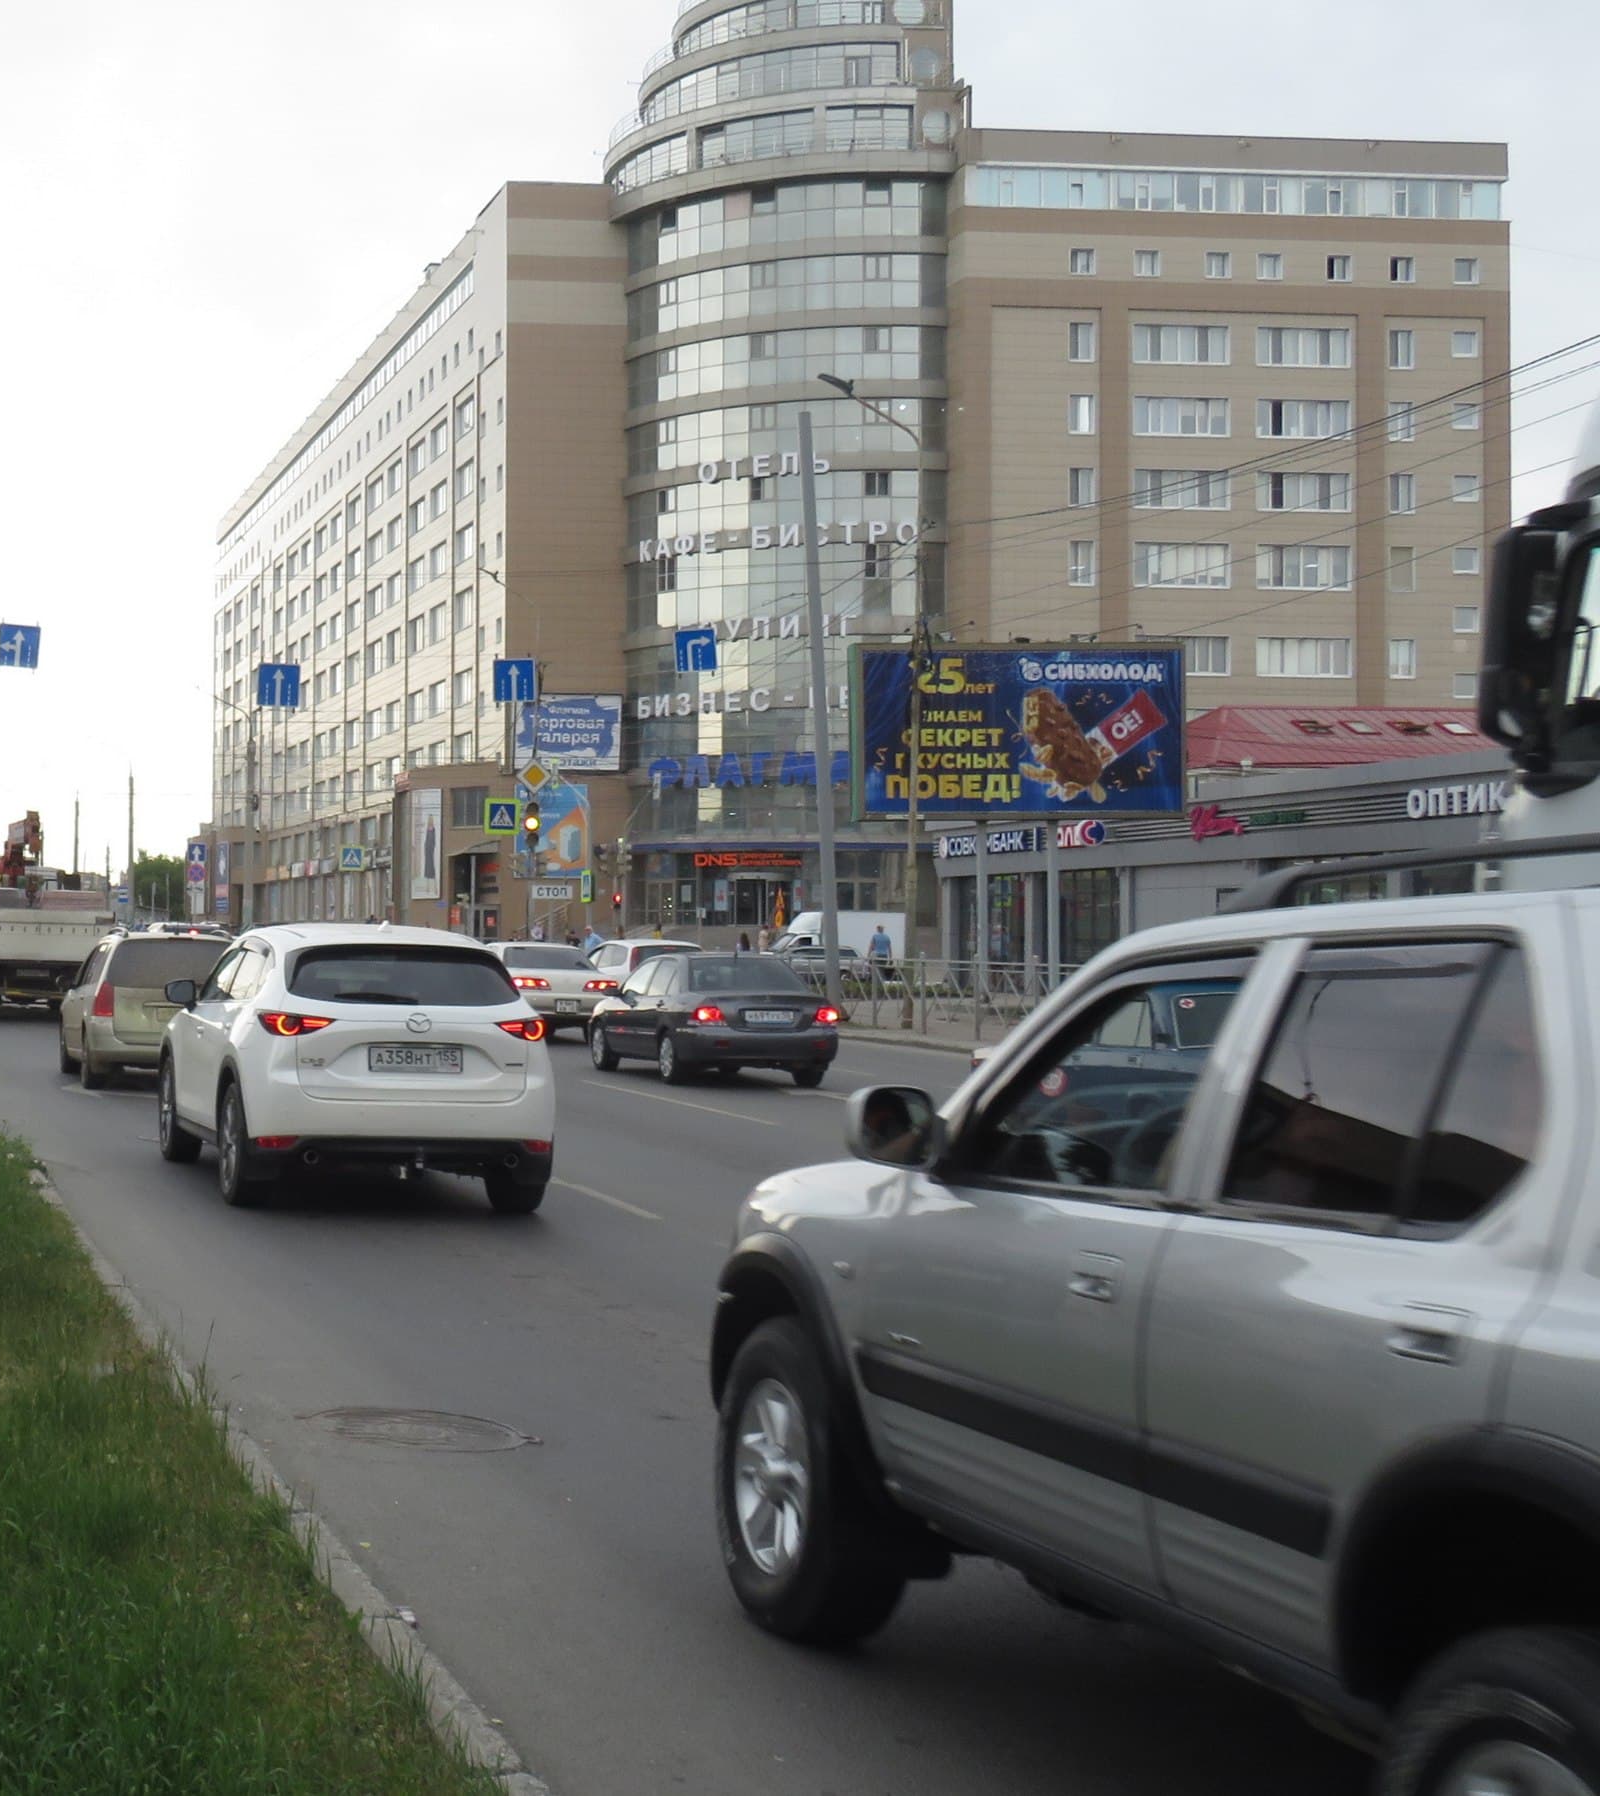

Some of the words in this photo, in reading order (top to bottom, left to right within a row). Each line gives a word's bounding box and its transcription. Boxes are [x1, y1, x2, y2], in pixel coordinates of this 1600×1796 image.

[697, 452, 831, 484] ОТЕЛЬ
[1044, 662, 1163, 683] СИБХОЛОД
[963, 683, 996, 694] лет
[885, 773, 1022, 803] ПОБЕД!
[948, 829, 1025, 858] СОВКБАНК
[693, 853, 738, 868] DNS
[536, 886, 568, 897] СТОП
[374, 1050, 432, 1065] А358НТ
[437, 1050, 457, 1062] 155
